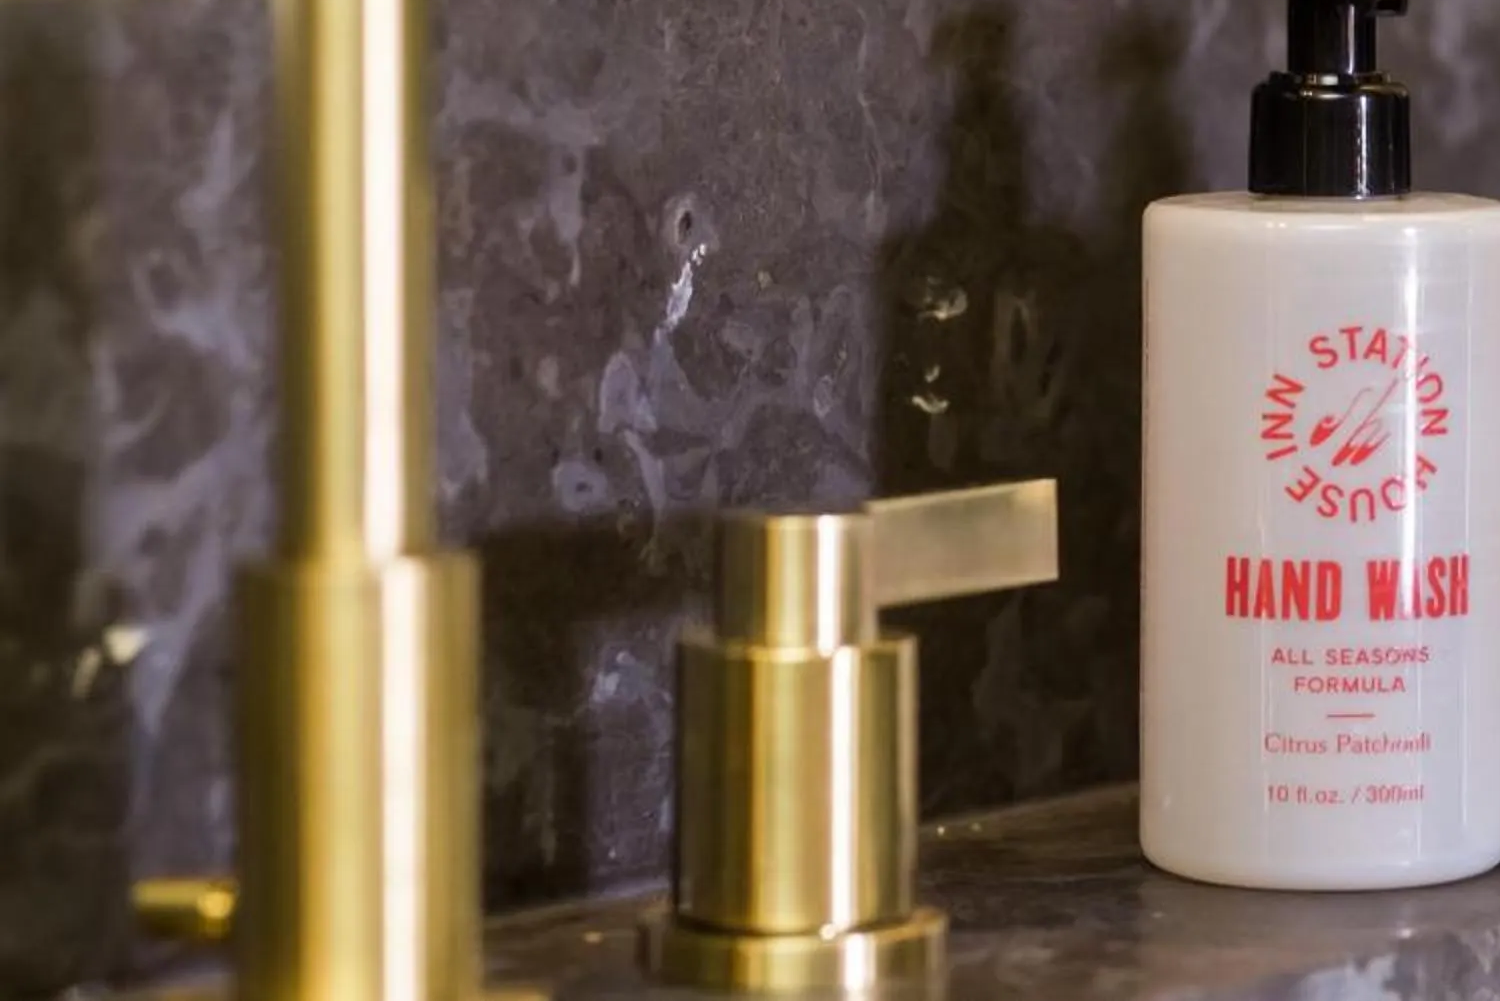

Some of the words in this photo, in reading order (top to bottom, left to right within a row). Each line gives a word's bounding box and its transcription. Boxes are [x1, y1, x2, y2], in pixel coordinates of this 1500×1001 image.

[1262, 373, 1304, 460] INN
[1225, 556, 1342, 621] HAND
[1271, 647, 1313, 665] ALL
[1325, 646, 1430, 666] SEASONS
[1294, 676, 1406, 693] FORMULA
[1264, 732, 1327, 754] Citrus
[1267, 785, 1289, 803] 10
